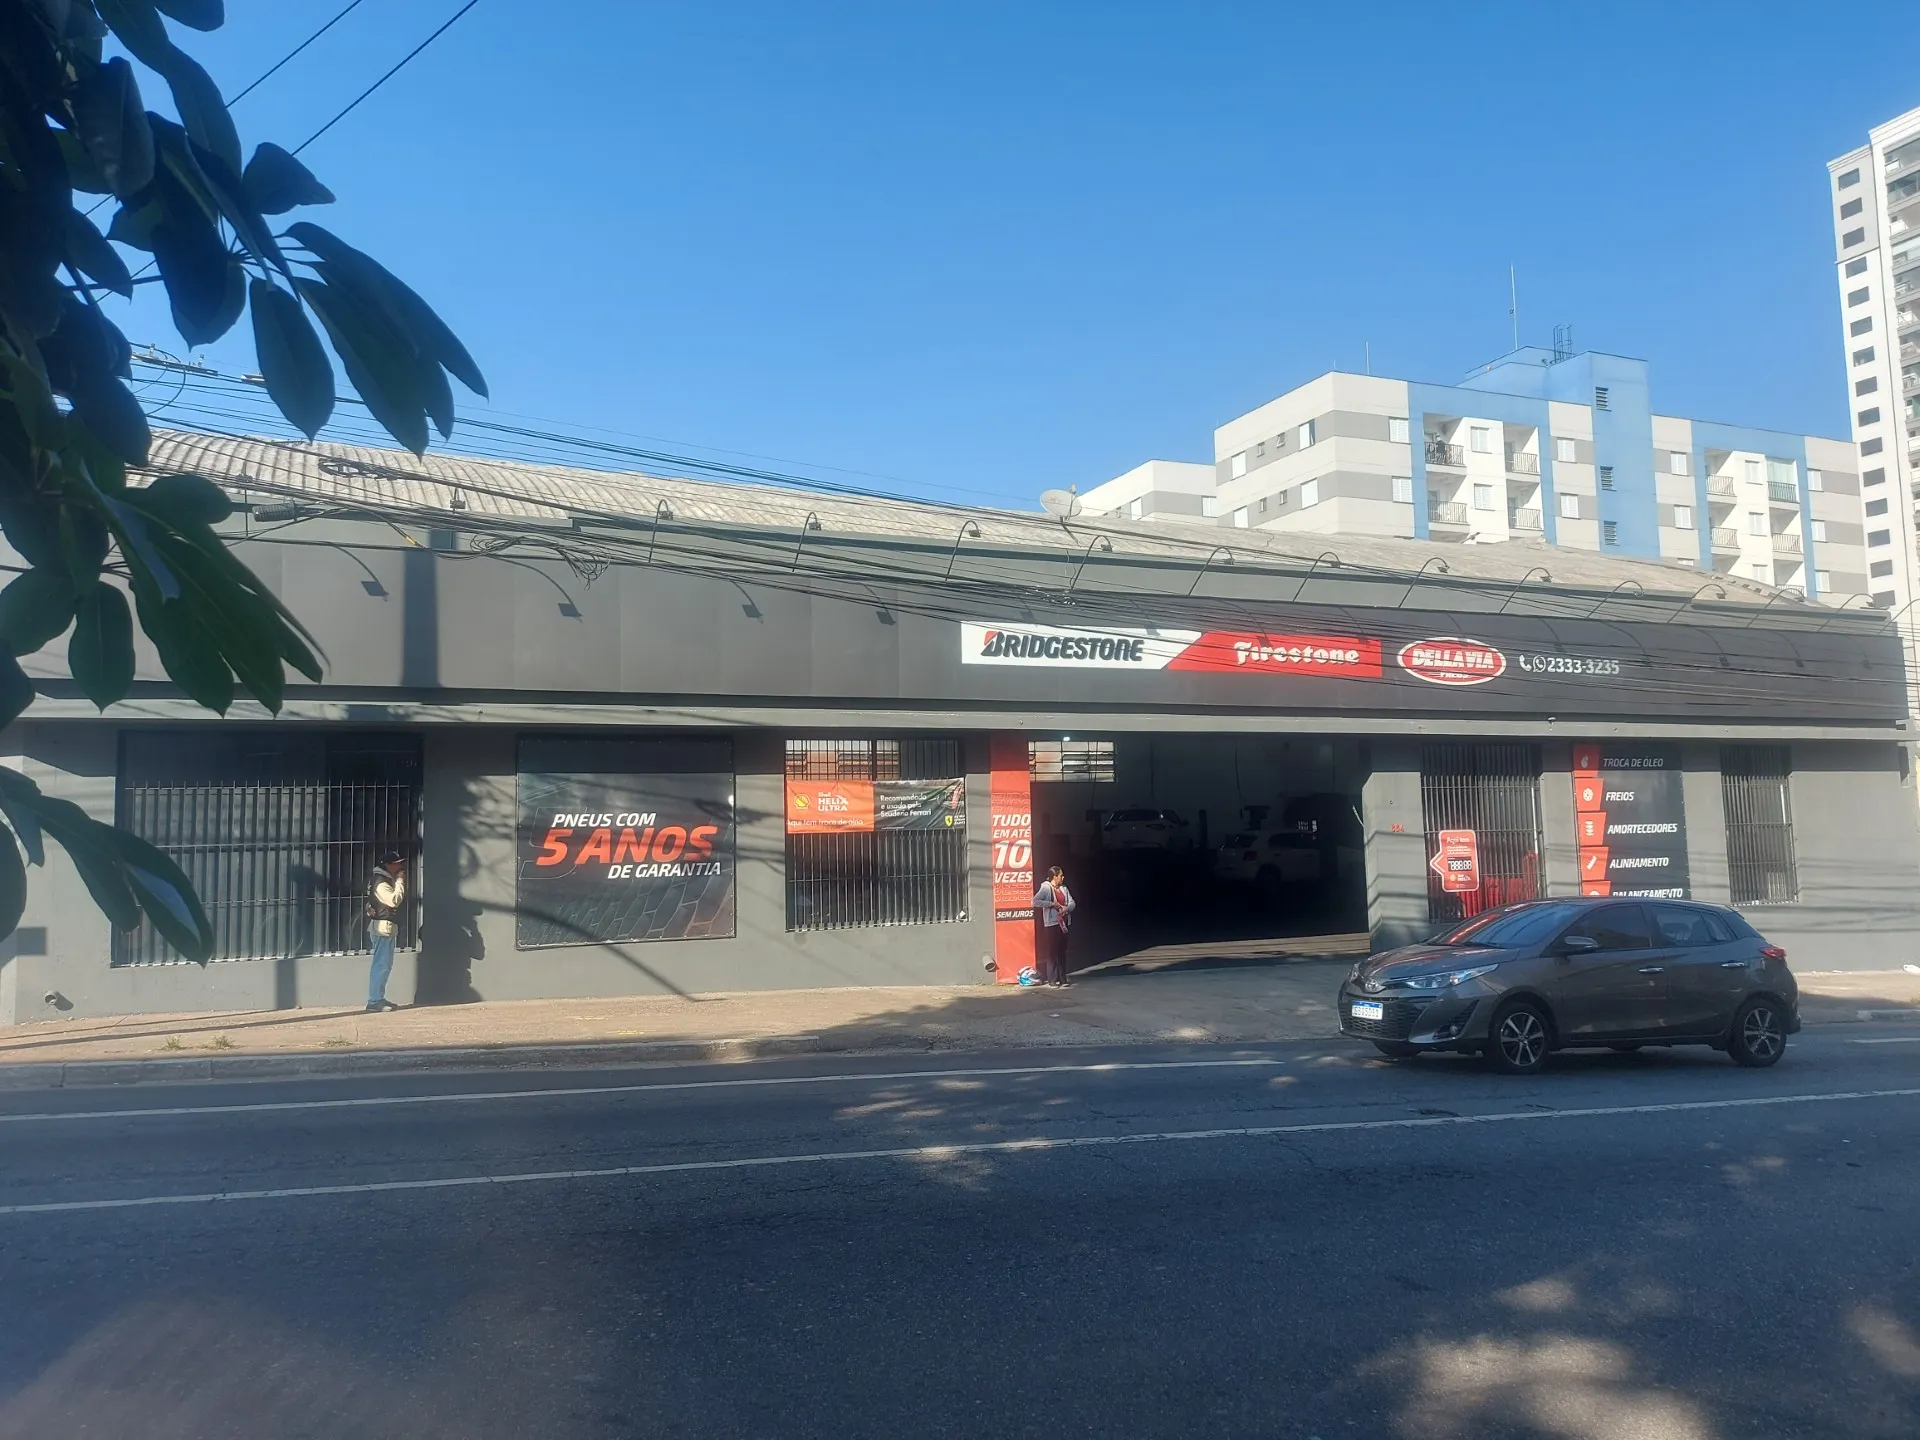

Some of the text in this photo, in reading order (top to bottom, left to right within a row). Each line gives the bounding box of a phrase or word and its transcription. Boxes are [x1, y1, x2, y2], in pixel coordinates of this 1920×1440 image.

[981, 631, 1144, 661] BRIDGESTONE
[1234, 641, 1360, 665] Firestone
[1547, 657, 1620, 675] 2333-3235
[1603, 756, 1664, 767] TROCA DE ÓLEO
[1605, 791, 1635, 801] FREIOS
[552, 813, 656, 828] PNEUS COM
[992, 814, 1031, 827] TUDO
[993, 826, 1031, 839] EM ATÉ
[1607, 823, 1678, 834] AMORTECEDORES
[536, 826, 718, 866] 5 ANOS
[994, 839, 1032, 869] 10
[1609, 857, 1670, 869] ALINHAMENTO
[607, 862, 721, 879] DE GARANTIA
[994, 871, 1033, 883] VEZES
[996, 910, 1034, 919] SEM JUROS
